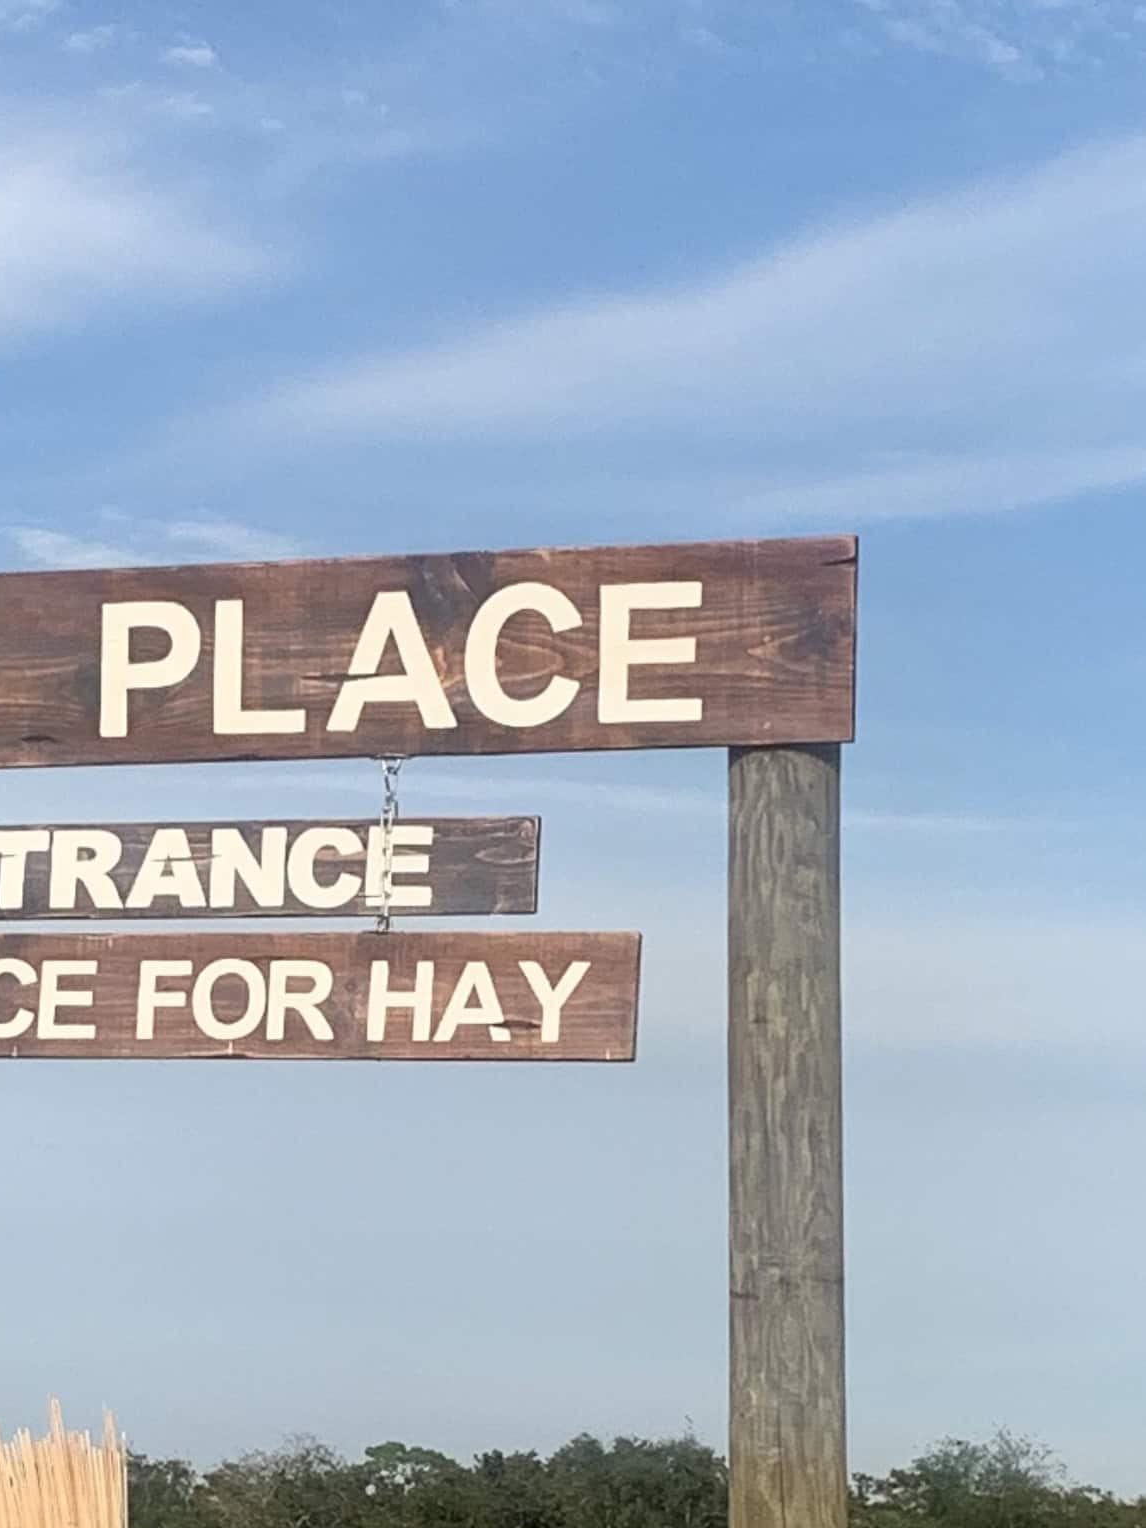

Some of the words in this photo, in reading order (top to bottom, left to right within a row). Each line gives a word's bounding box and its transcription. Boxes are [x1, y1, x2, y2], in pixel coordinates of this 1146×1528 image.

[98, 582, 703, 738] PLACE
[135, 958, 335, 1041] FOR
[366, 960, 592, 1043] HAY
